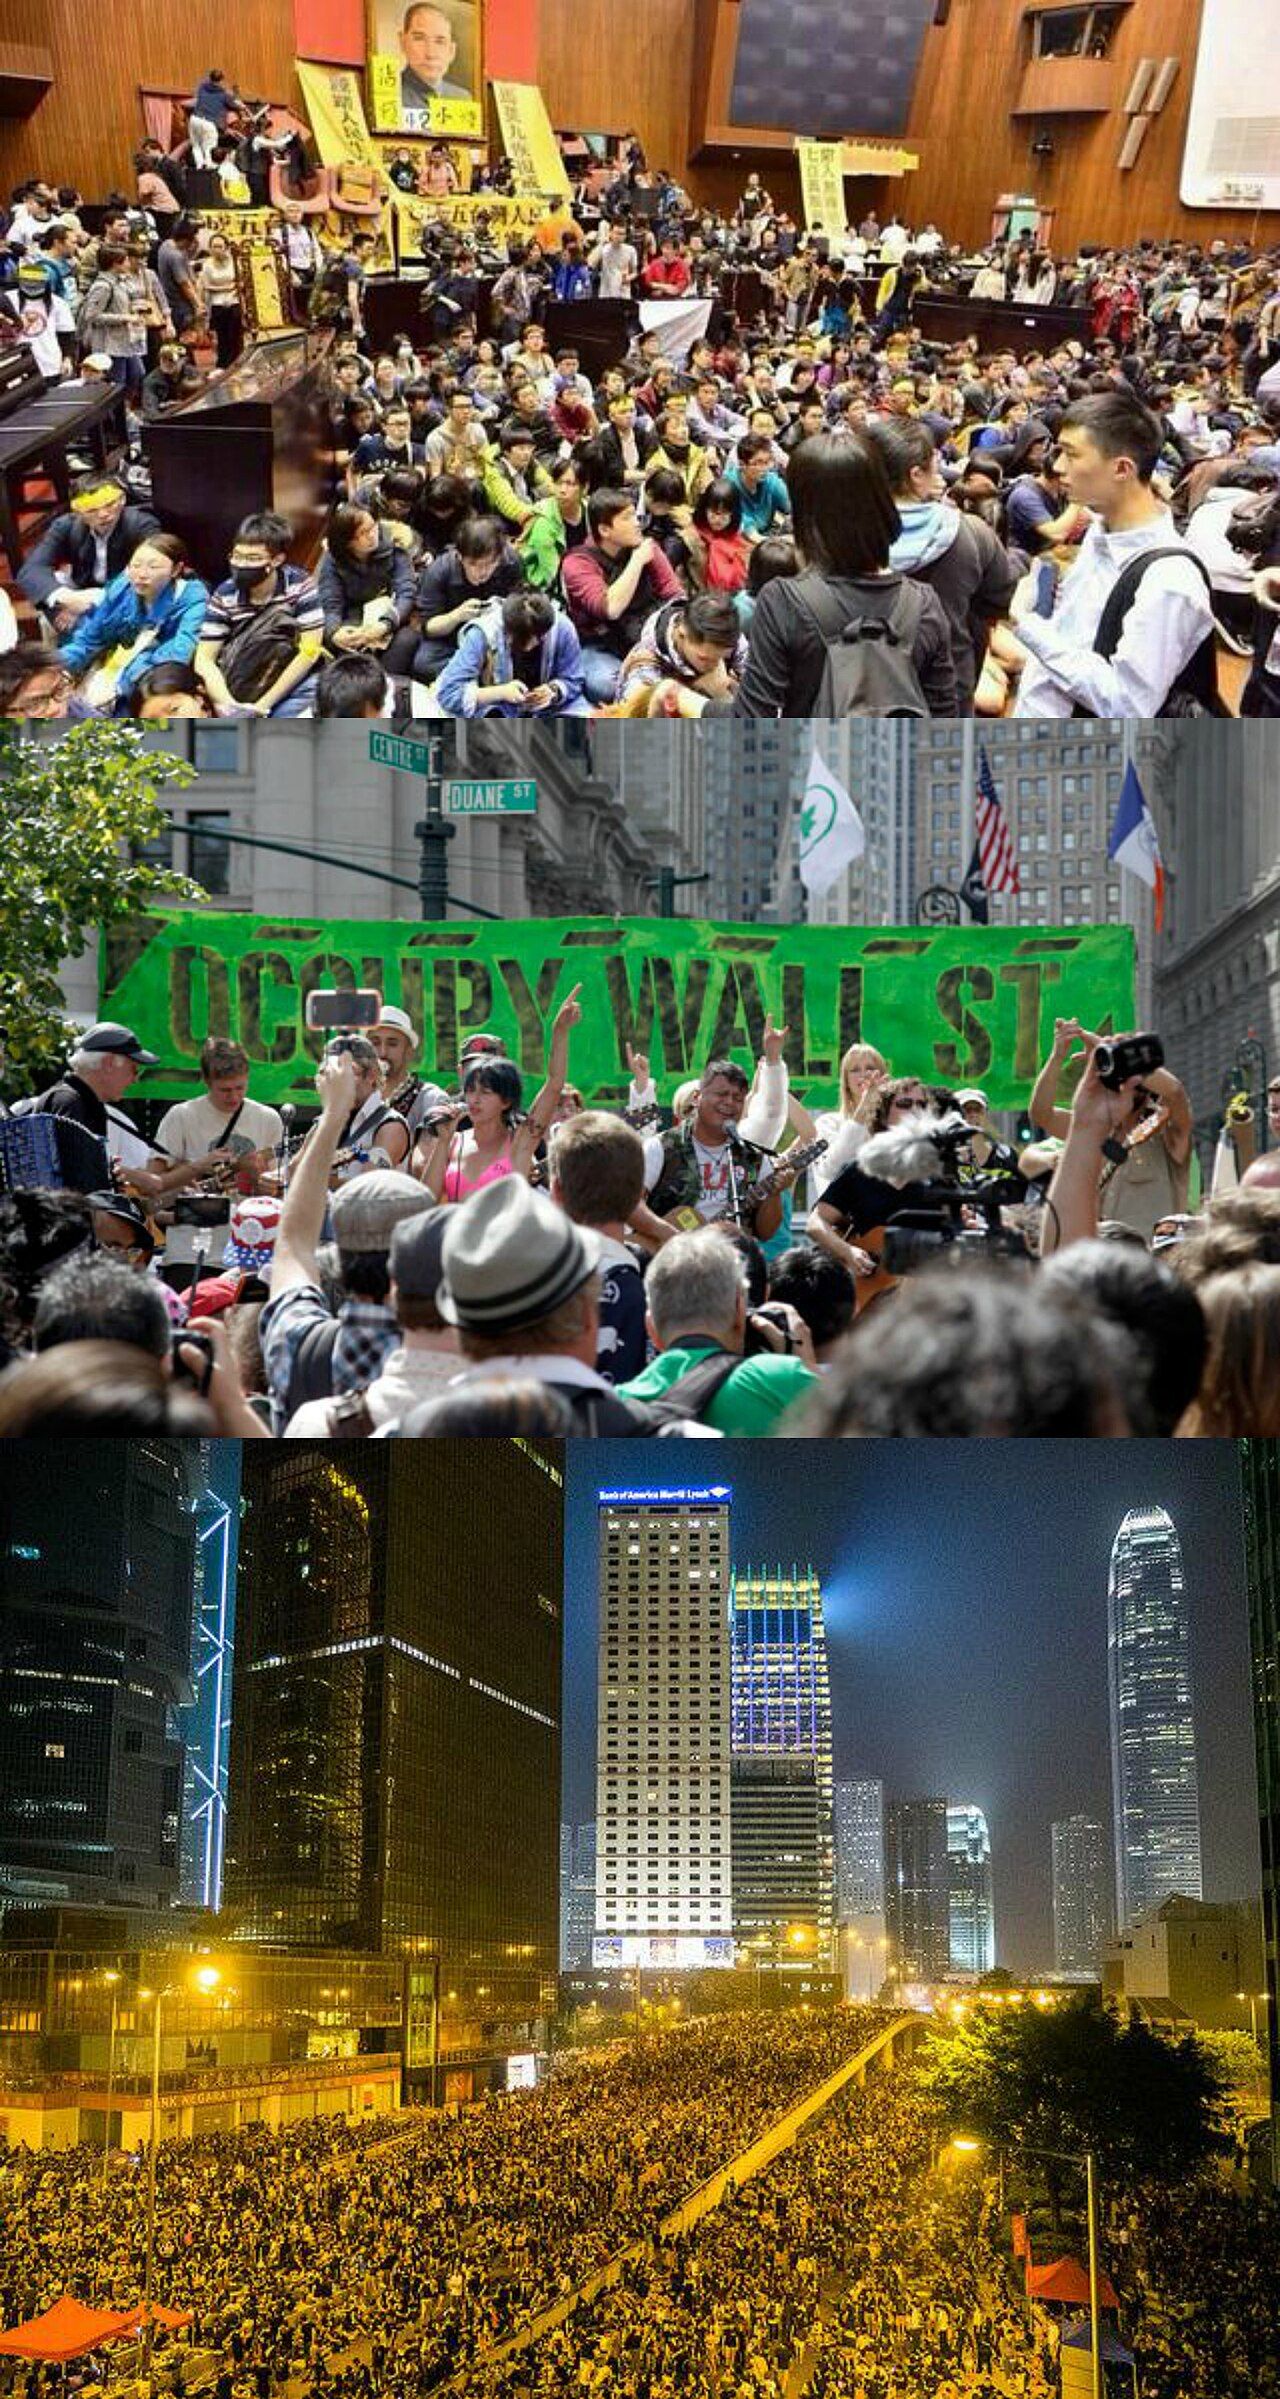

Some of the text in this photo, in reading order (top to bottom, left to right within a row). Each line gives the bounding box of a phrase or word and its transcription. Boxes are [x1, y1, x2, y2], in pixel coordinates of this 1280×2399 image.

[373, 734, 413, 769] CENTRE
[451, 783, 531, 809] DUANE ST
[168, 943, 566, 1076] OCCUPY
[932, 962, 1062, 1082] ST
